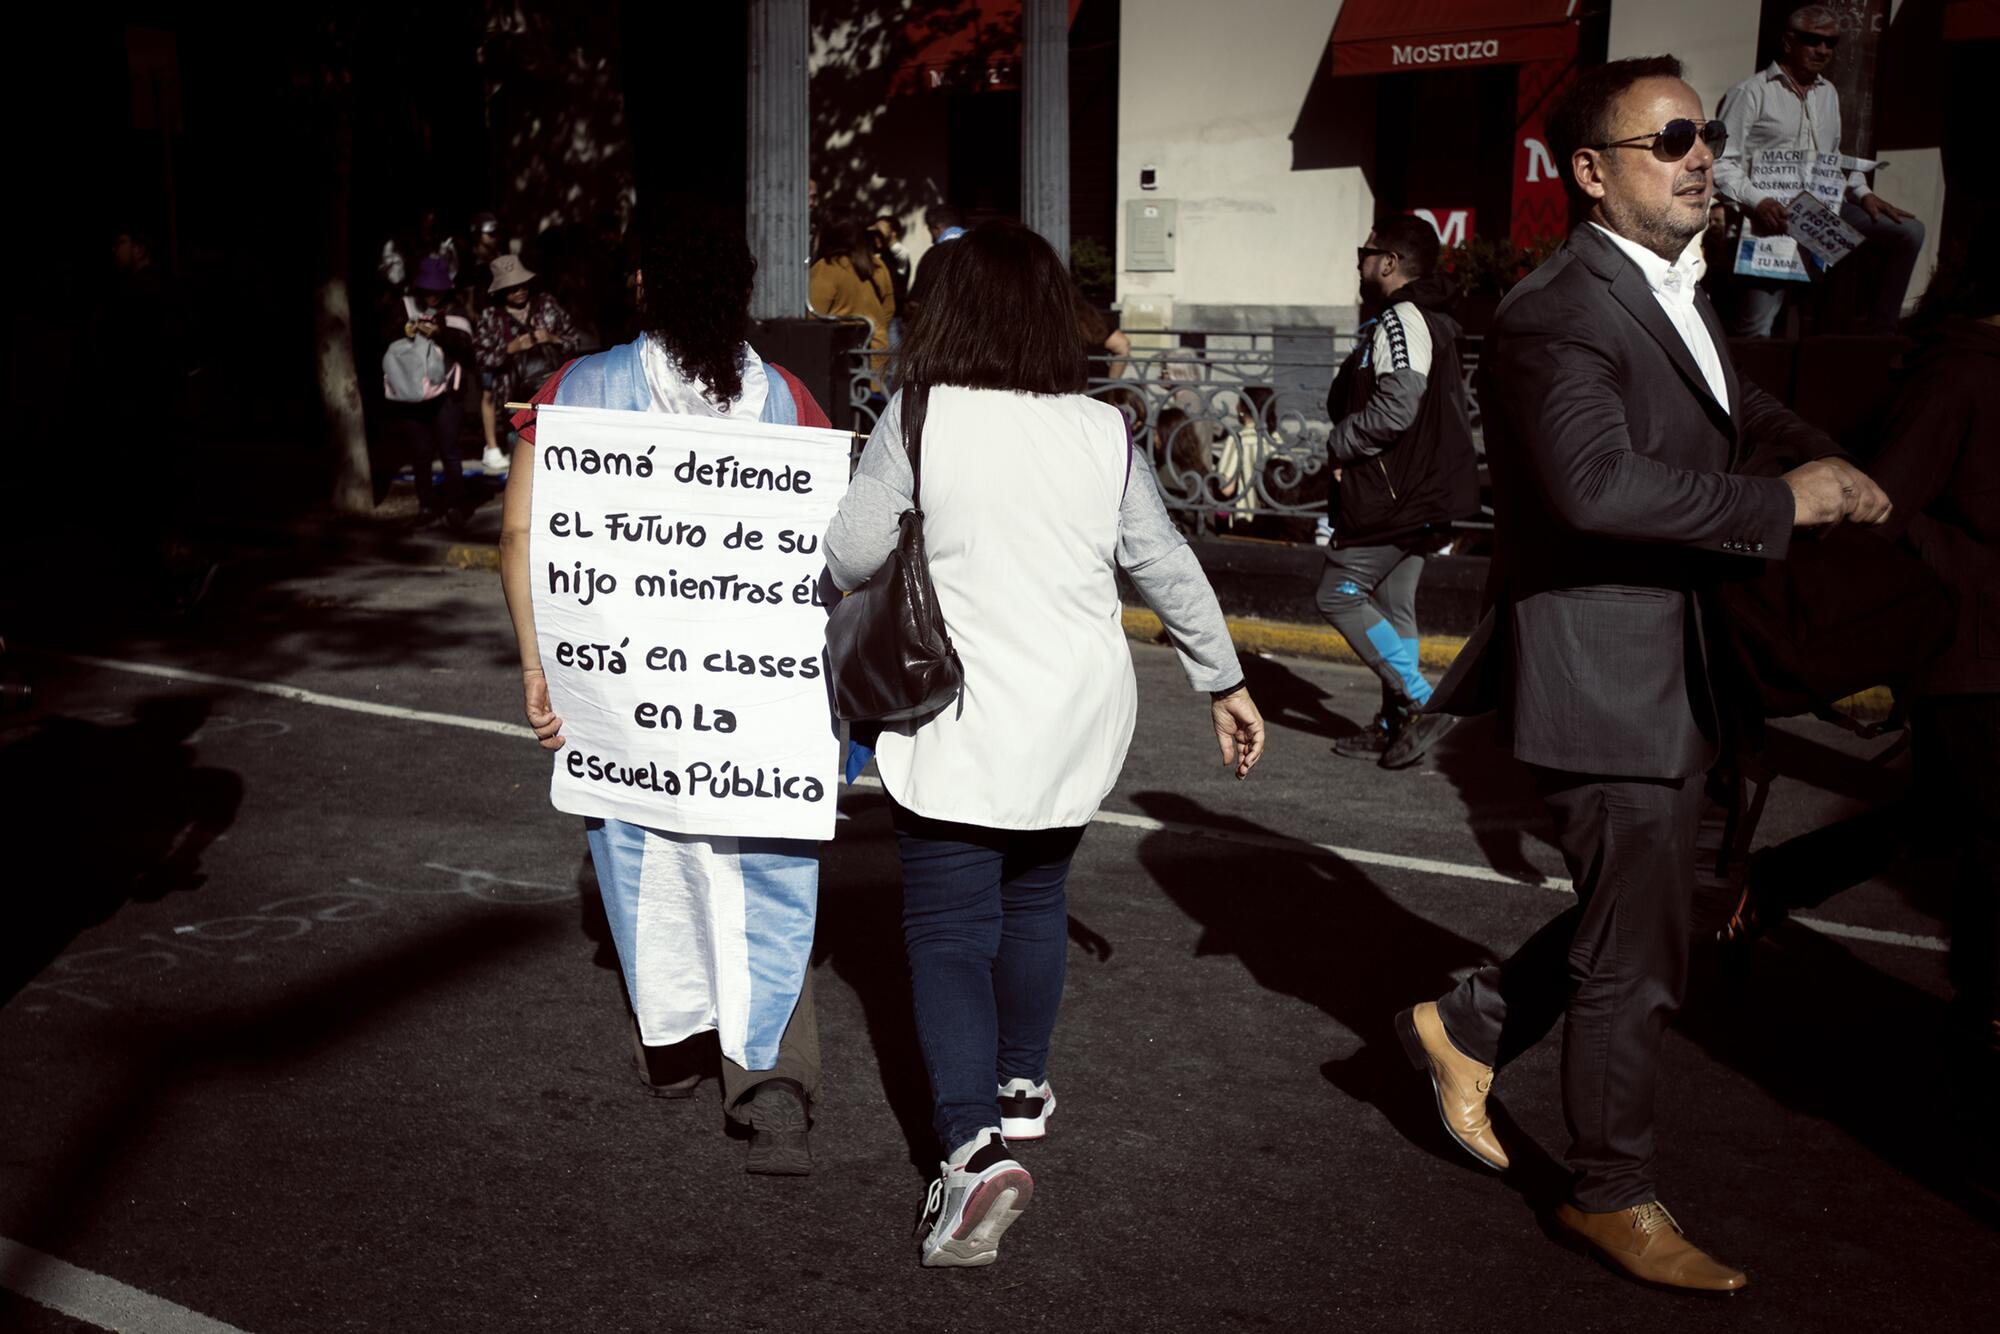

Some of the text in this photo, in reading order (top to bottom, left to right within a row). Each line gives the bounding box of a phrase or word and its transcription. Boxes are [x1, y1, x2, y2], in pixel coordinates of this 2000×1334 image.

[1391, 39, 1499, 65] Mostaza
[1761, 150, 1804, 161] MACRI
[1753, 165, 1796, 175] ROSATTI
[544, 444, 656, 478] mamá
[723, 521, 764, 551] de
[778, 529, 817, 554] su
[548, 560, 617, 606] hijo
[646, 646, 687, 673] en
[634, 702, 682, 730] en
